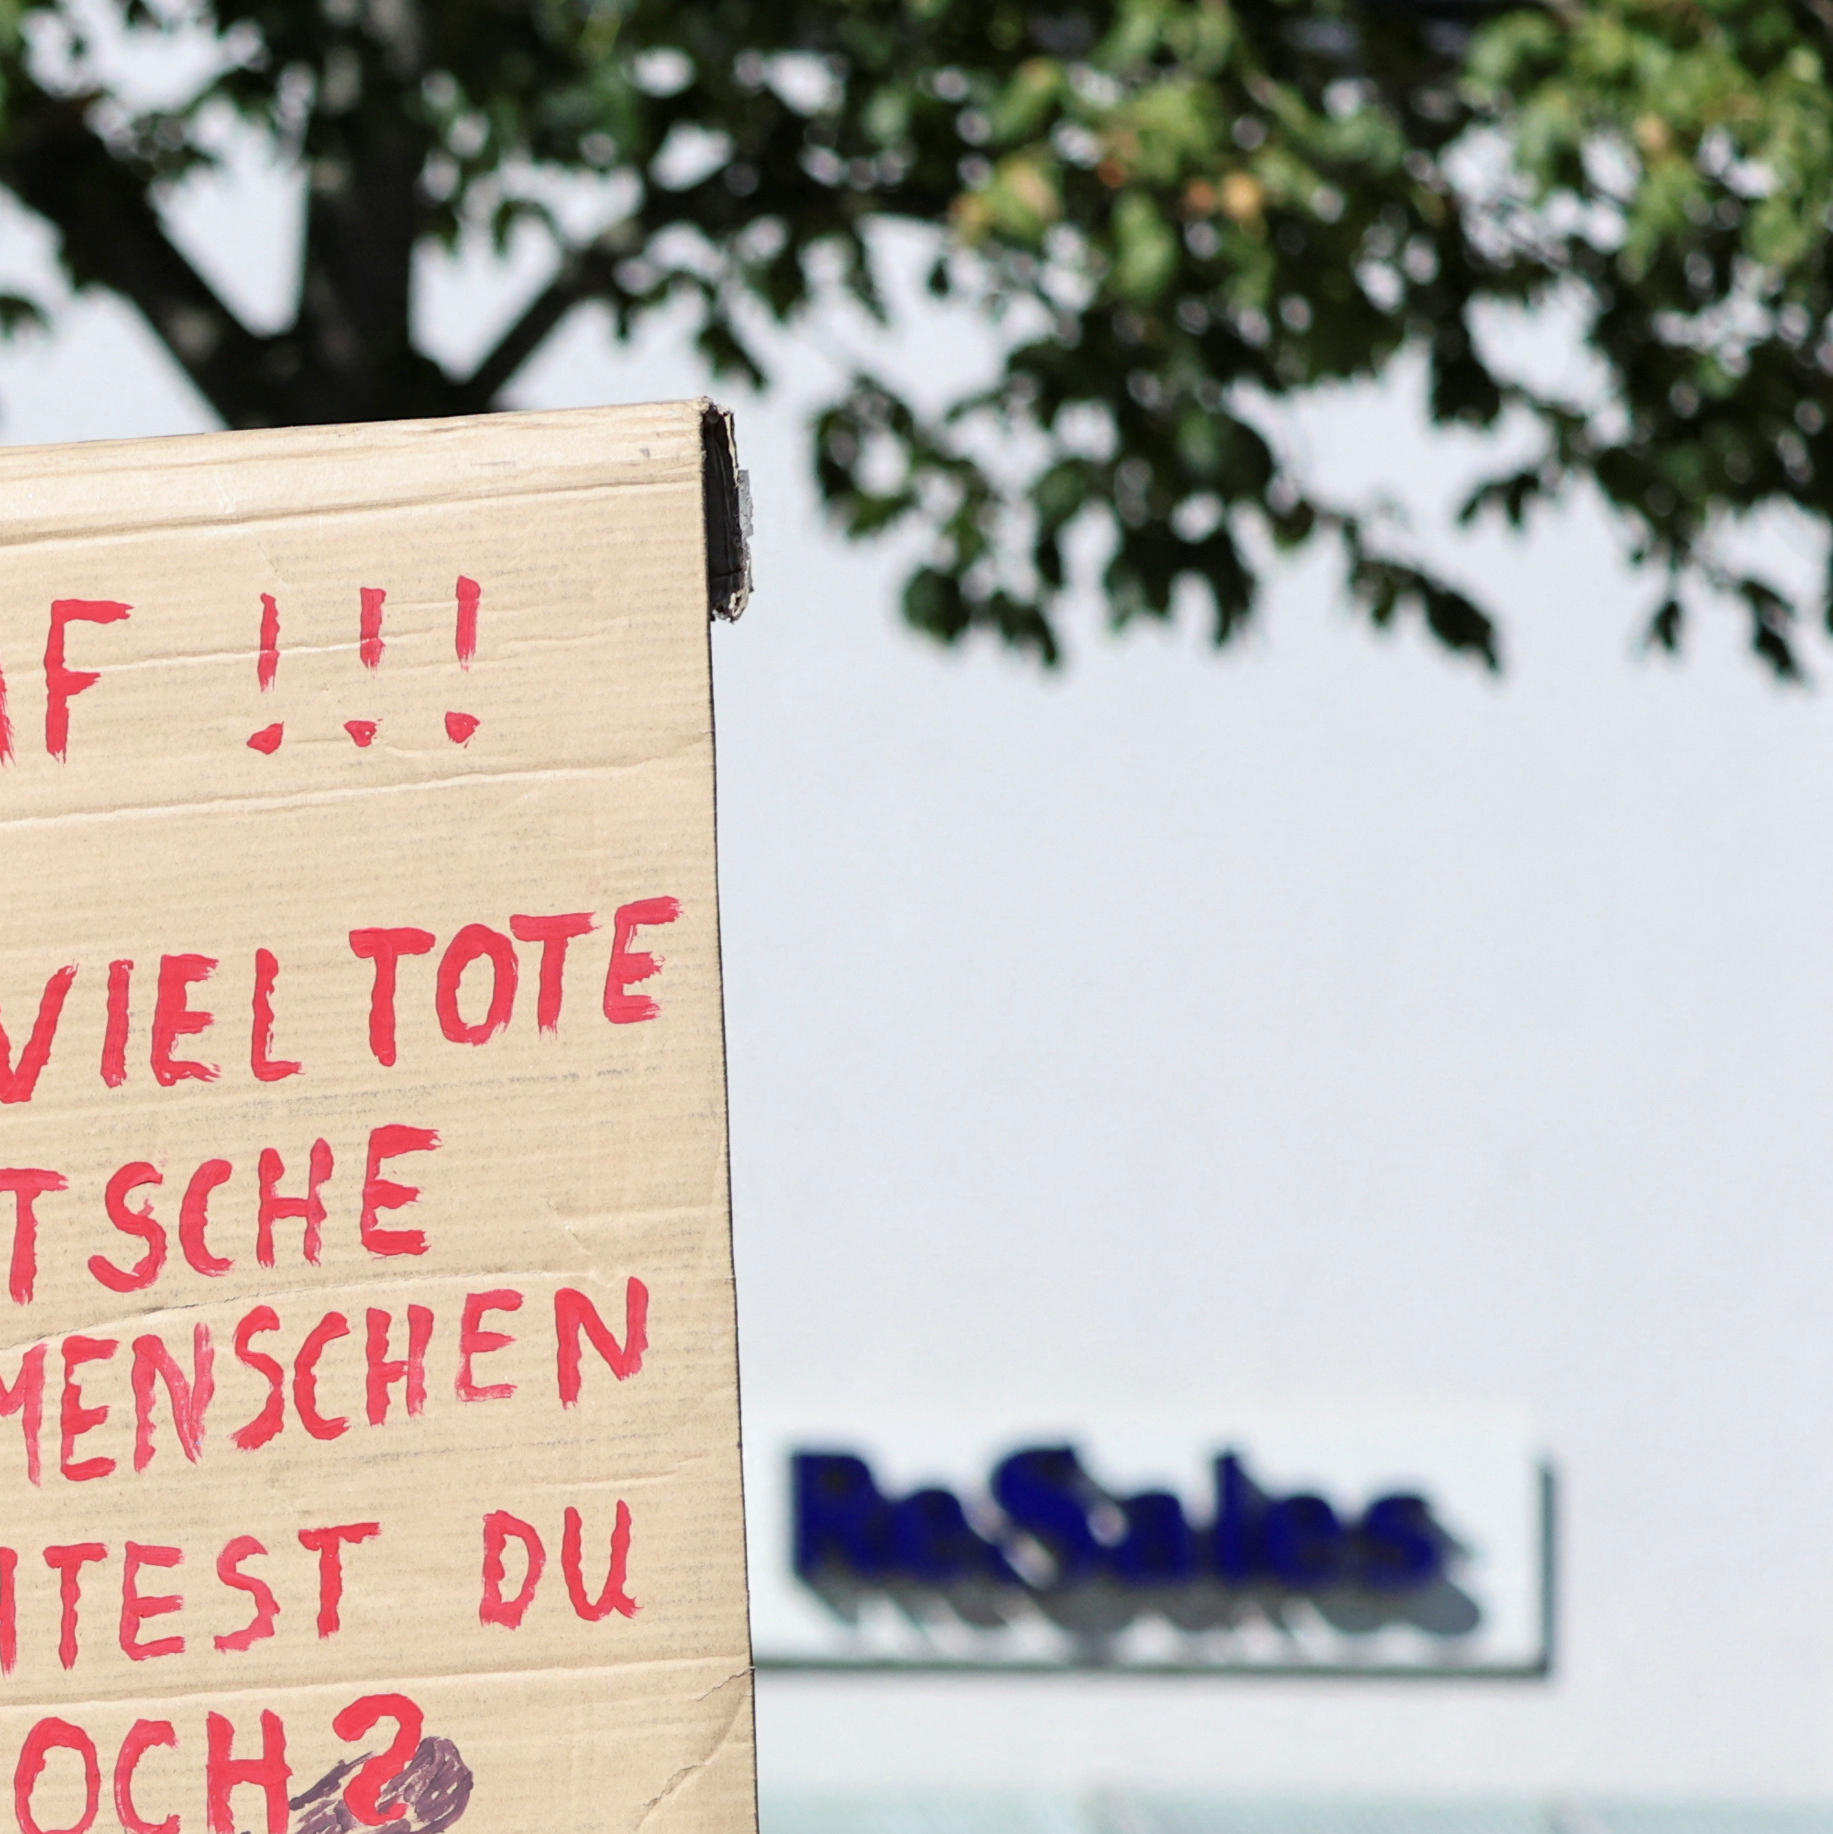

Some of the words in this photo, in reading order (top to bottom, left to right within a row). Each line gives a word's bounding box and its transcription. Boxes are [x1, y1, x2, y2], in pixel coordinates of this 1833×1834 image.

[246, 574, 483, 756] !!!
[348, 895, 685, 1068] TOTE
[478, 1498, 644, 1632] DU
